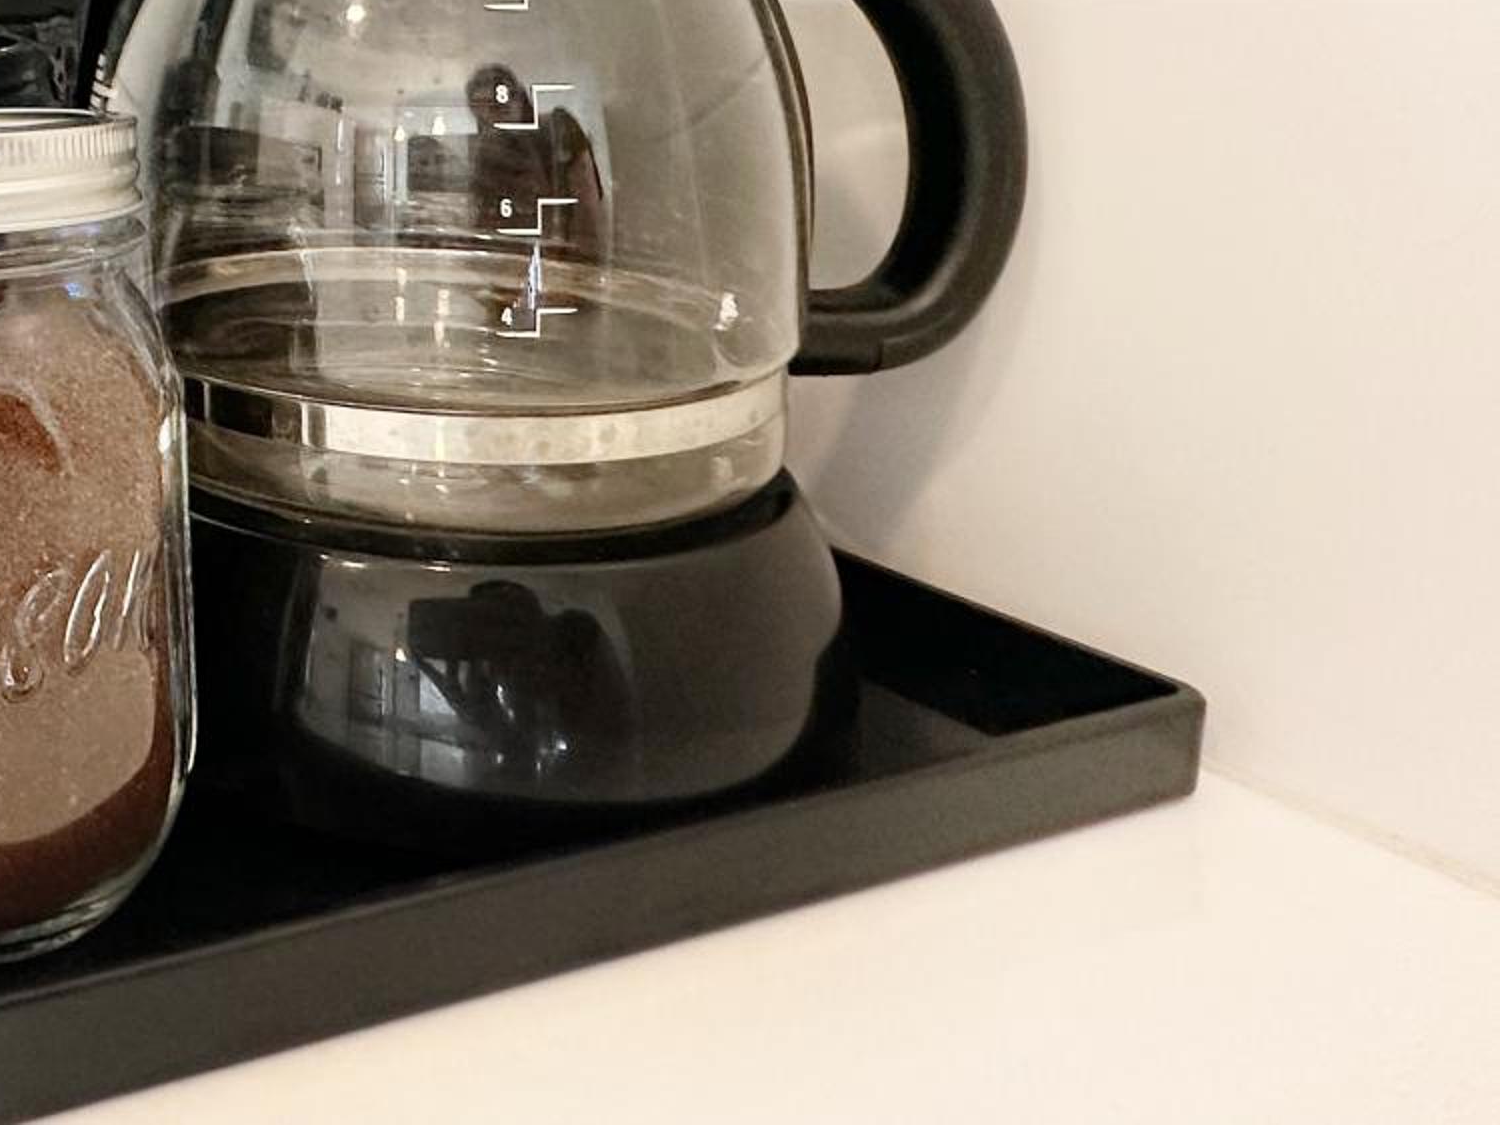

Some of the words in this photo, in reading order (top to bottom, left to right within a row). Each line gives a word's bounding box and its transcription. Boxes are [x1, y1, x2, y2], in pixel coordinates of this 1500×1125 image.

[495, 84, 509, 104] 8
[500, 198, 513, 218] 6
[501, 307, 514, 326] 4
